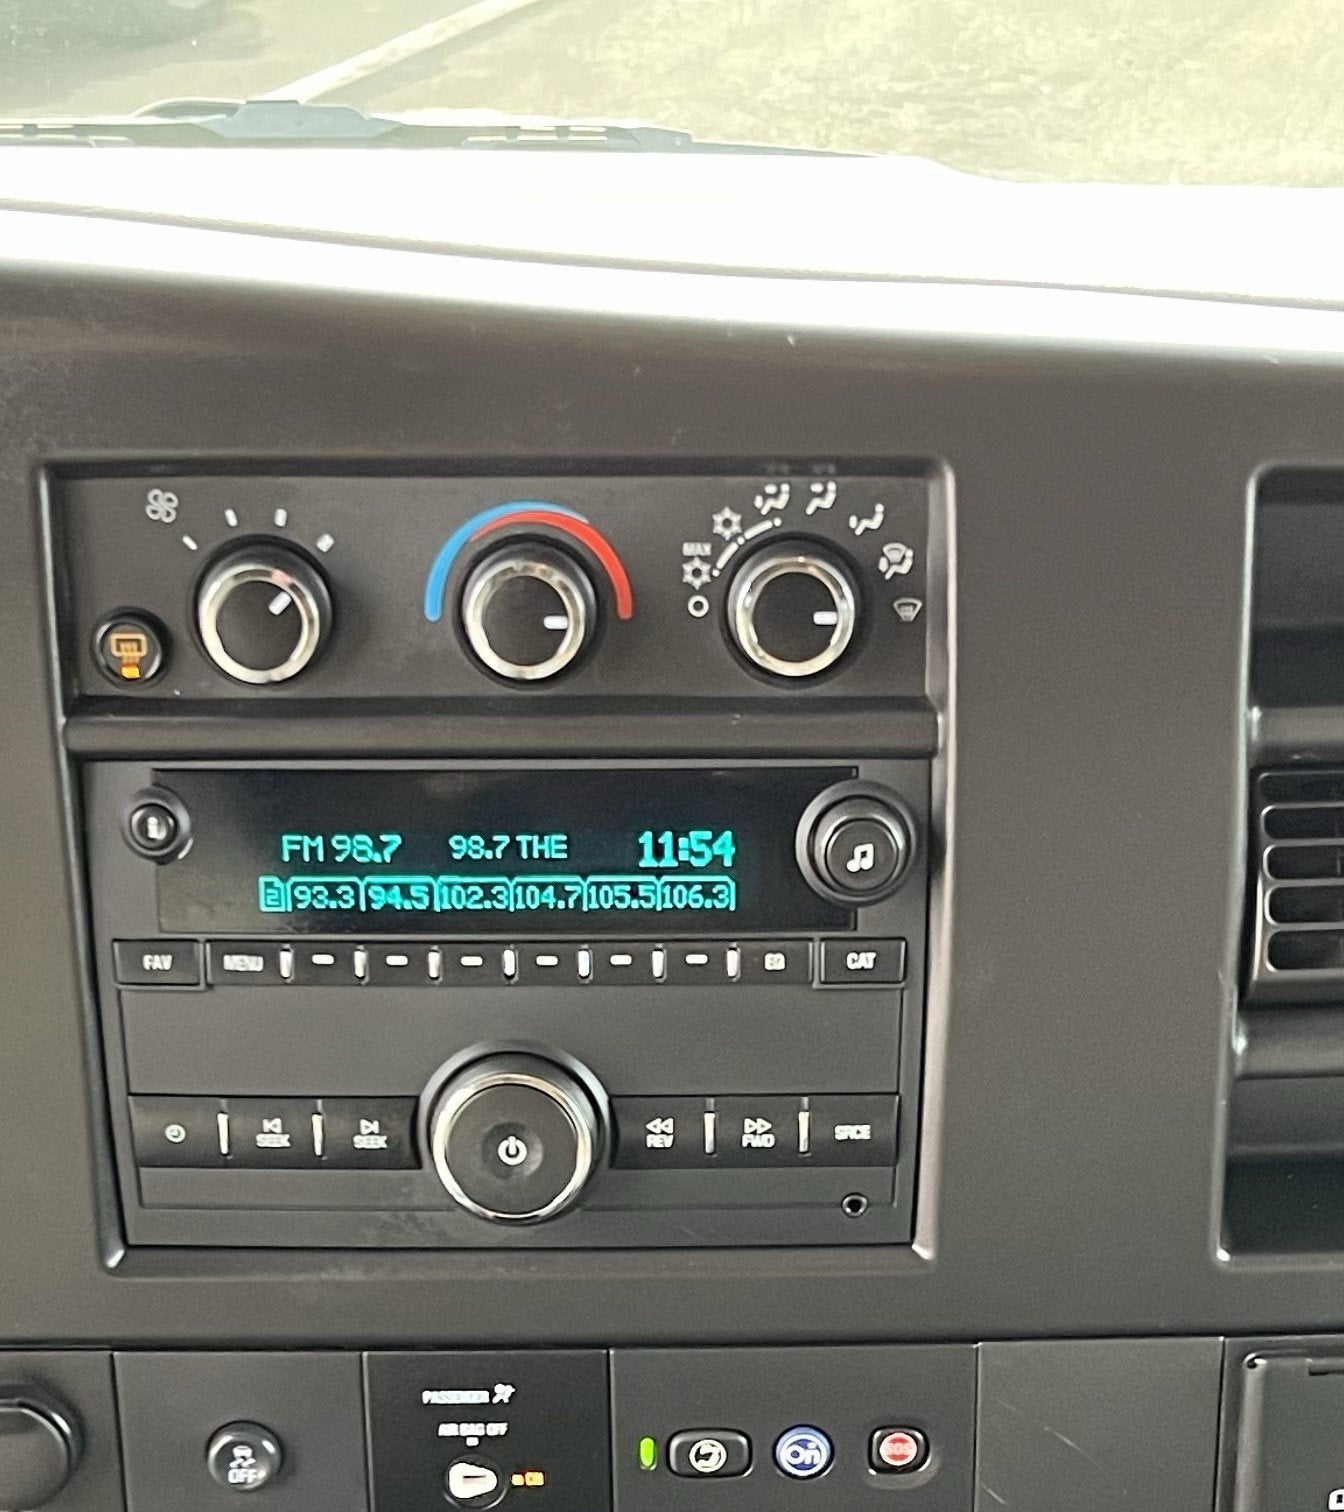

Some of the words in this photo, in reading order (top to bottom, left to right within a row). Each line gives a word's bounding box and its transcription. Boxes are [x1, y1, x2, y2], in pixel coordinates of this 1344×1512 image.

[682, 542, 711, 557] MAX
[281, 834, 324, 862] FM
[331, 834, 403, 863] 98.7
[448, 834, 510, 860] 98.7
[515, 834, 568, 860] THE
[638, 830, 736, 868] 11:54
[293, 885, 356, 909] 93.3
[367, 885, 431, 910] 94.5
[439, 885, 509, 910] 102.3
[514, 885, 582, 909] 104.7
[587, 885, 655, 910] 105.5
[660, 885, 730, 910] 106.3
[142, 954, 173, 971] FAV
[846, 951, 876, 970] CAT
[646, 1133, 674, 1148] REV
[741, 1133, 775, 1148] FWD
